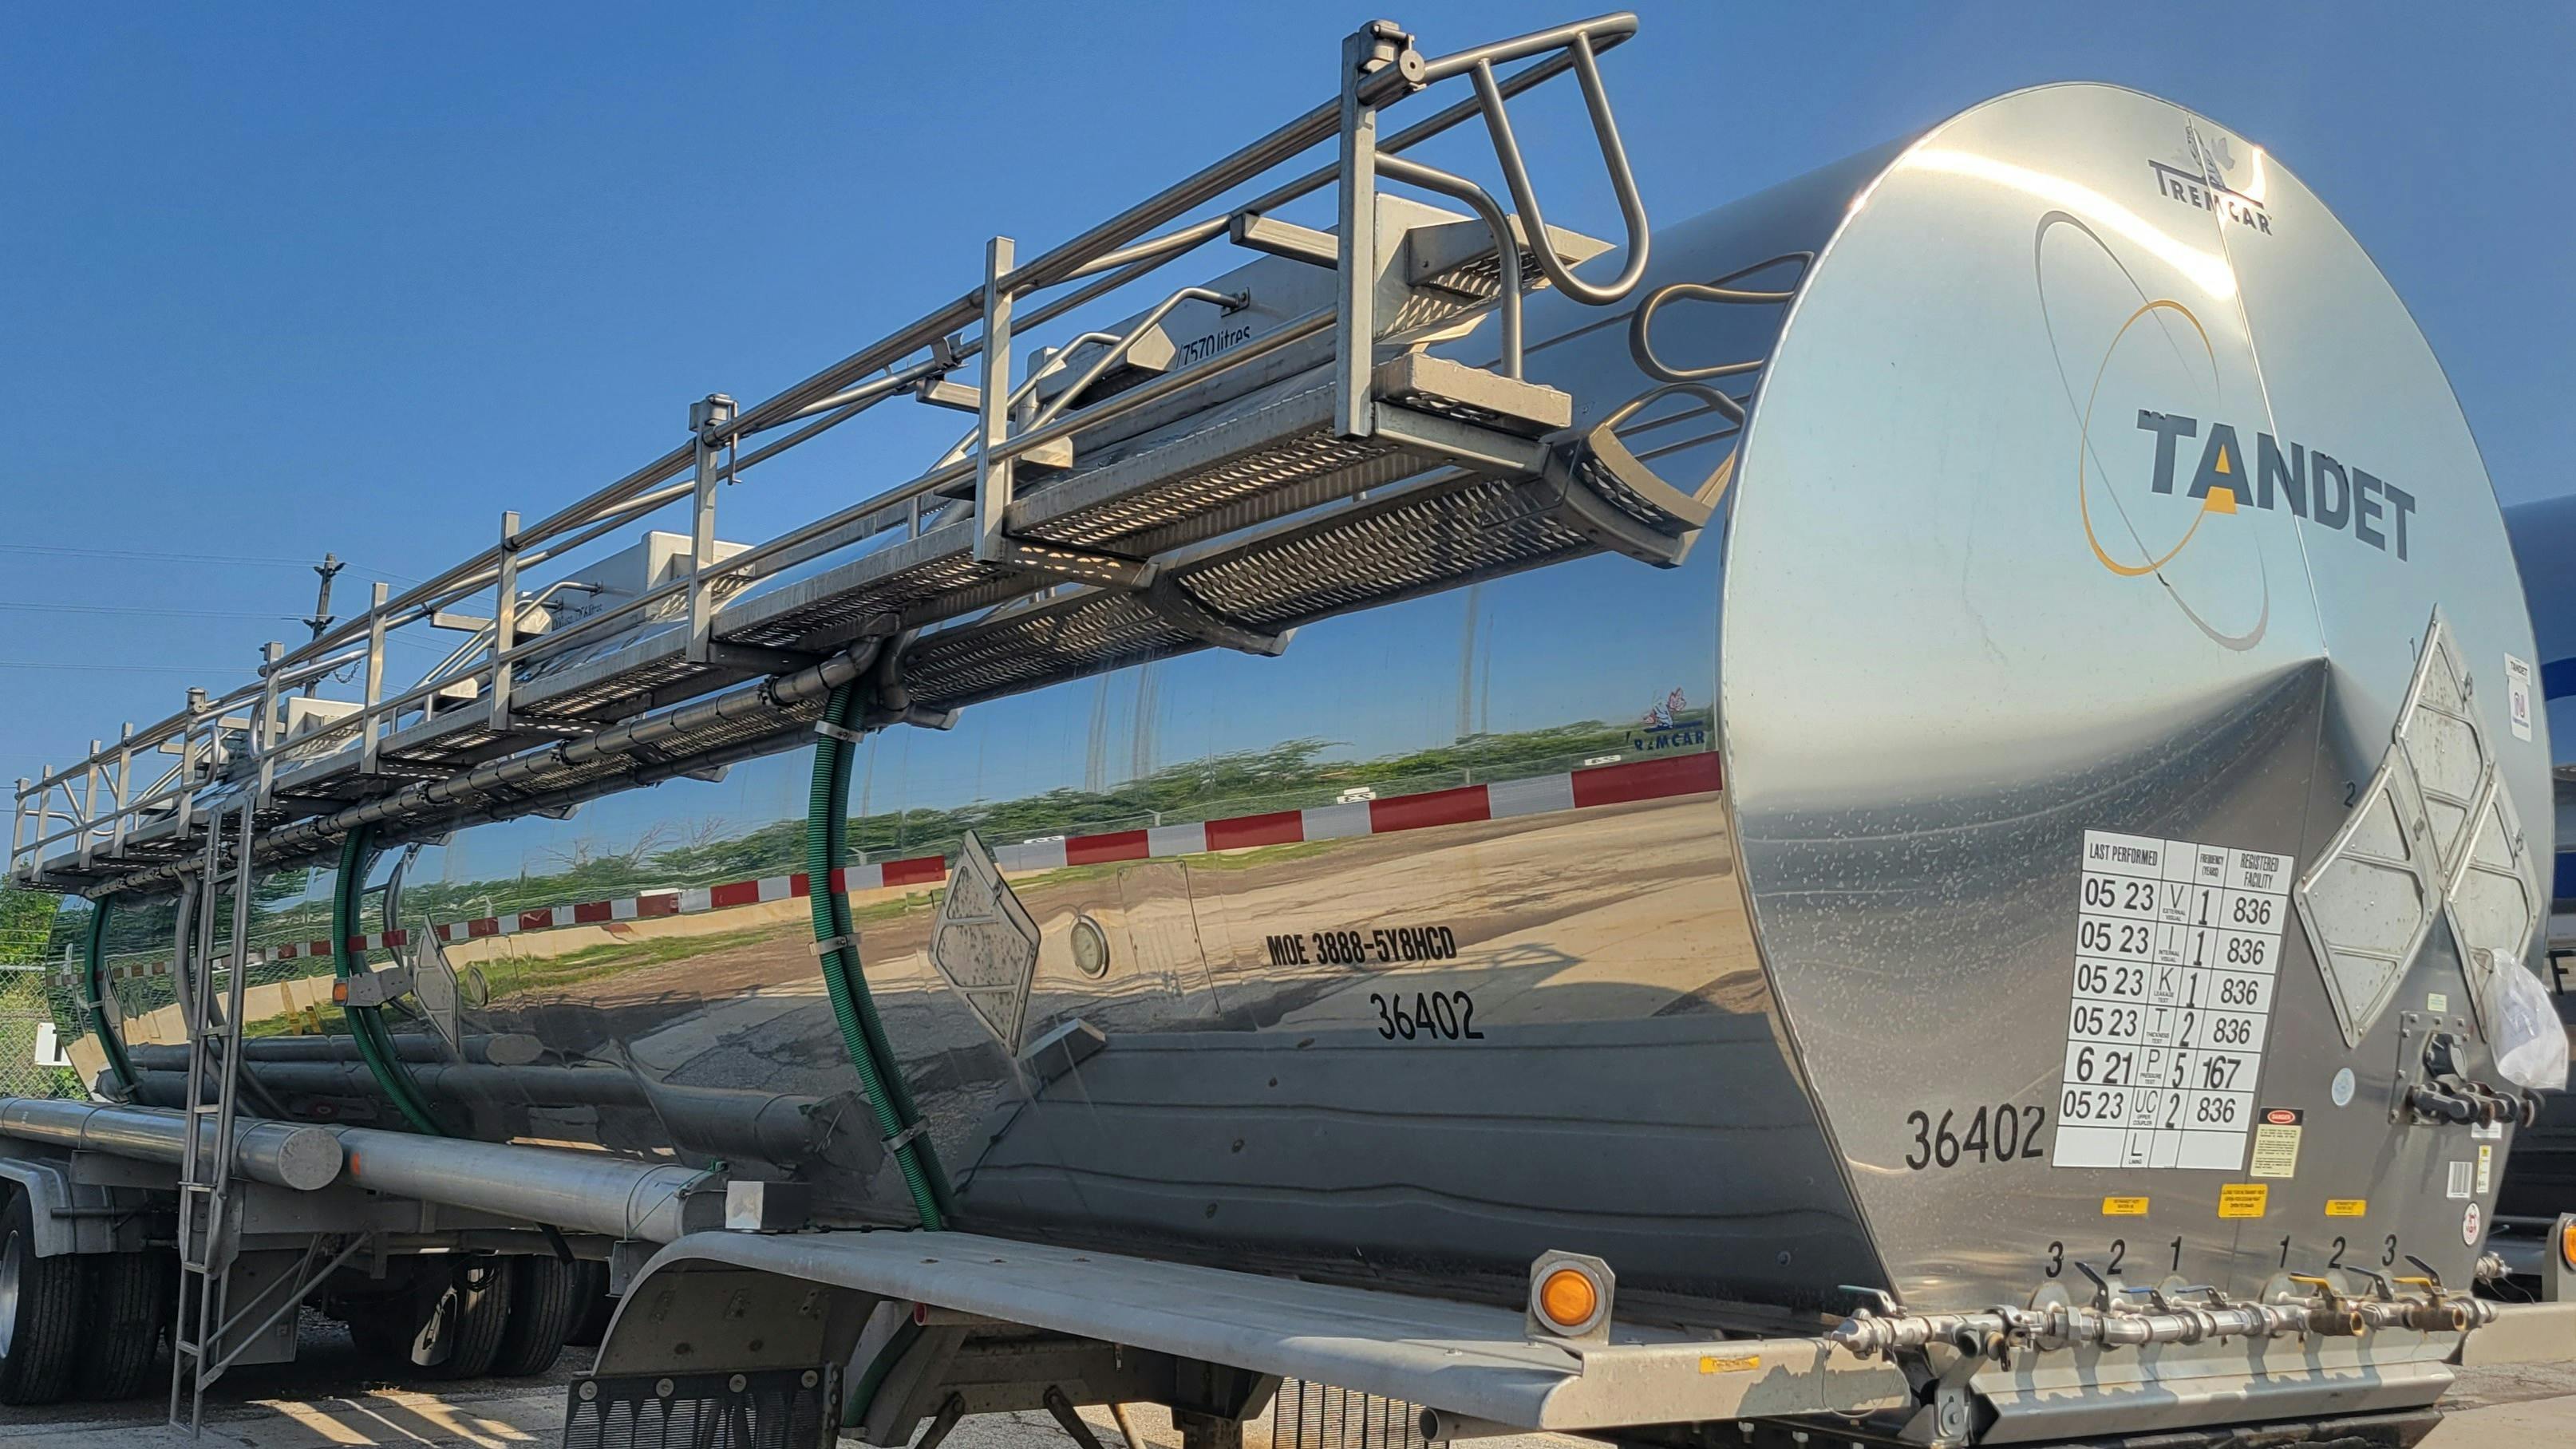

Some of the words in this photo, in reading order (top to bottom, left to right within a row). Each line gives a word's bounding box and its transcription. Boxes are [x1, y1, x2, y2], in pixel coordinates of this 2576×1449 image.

[1217, 326, 1250, 352] litres
[2136, 409, 2416, 562] TANDET
[2409, 638, 2416, 661] 1
[2344, 782, 2356, 808] 2
[2089, 843, 2110, 860] LAST
[2112, 846, 2158, 866] PERFORMED
[2200, 853, 2224, 865] FREQUENCY
[2240, 853, 2279, 872] REGISTERED
[2244, 871, 2273, 889] FACILITY
[2085, 878, 2116, 907] 05
[2124, 882, 2154, 910] 23
[2171, 884, 2184, 908] V
[2199, 889, 2210, 925] 1
[2233, 897, 2272, 925] 836
[1266, 934, 1310, 965] MOE
[1312, 926, 1457, 964] 3888-5Y8HCD
[2080, 921, 2111, 952] 05
[2119, 925, 2149, 954] 23
[2193, 930, 2205, 965] 1
[2226, 937, 2265, 965] 836
[2078, 964, 2108, 993] 05
[2113, 967, 2143, 996] 23
[2159, 966, 2174, 991] K
[2186, 973, 2198, 1008] 1
[2221, 978, 2258, 1005] 836
[1370, 990, 1484, 1040] 36402
[2073, 1005, 2104, 1036] 05
[2108, 1009, 2138, 1036] 23
[2155, 1008, 2167, 1032] T
[2179, 1011, 2195, 1047] 2
[2213, 1017, 2251, 1044] 836
[2076, 1046, 2095, 1082] 6
[2103, 1051, 2133, 1084] 21
[2147, 1048, 2160, 1072] P
[2172, 1052, 2187, 1088] 5
[2202, 1055, 2241, 1089] 167
[2063, 1090, 2092, 1119] 05
[2095, 1092, 2124, 1119] 23
[2135, 1089, 2158, 1113] UC
[2165, 1092, 2180, 1129] 2
[2197, 1097, 2235, 1123] 836
[1906, 1103, 2045, 1170] 36402
[2131, 1132, 2143, 1156] L
[2045, 1241, 2064, 1277] 3
[2107, 1238, 2125, 1275] 2
[2171, 1236, 2183, 1271] 1
[2280, 1234, 2290, 1268] 1
[2328, 1236, 2346, 1269] 2
[2381, 1234, 2397, 1267] 3
